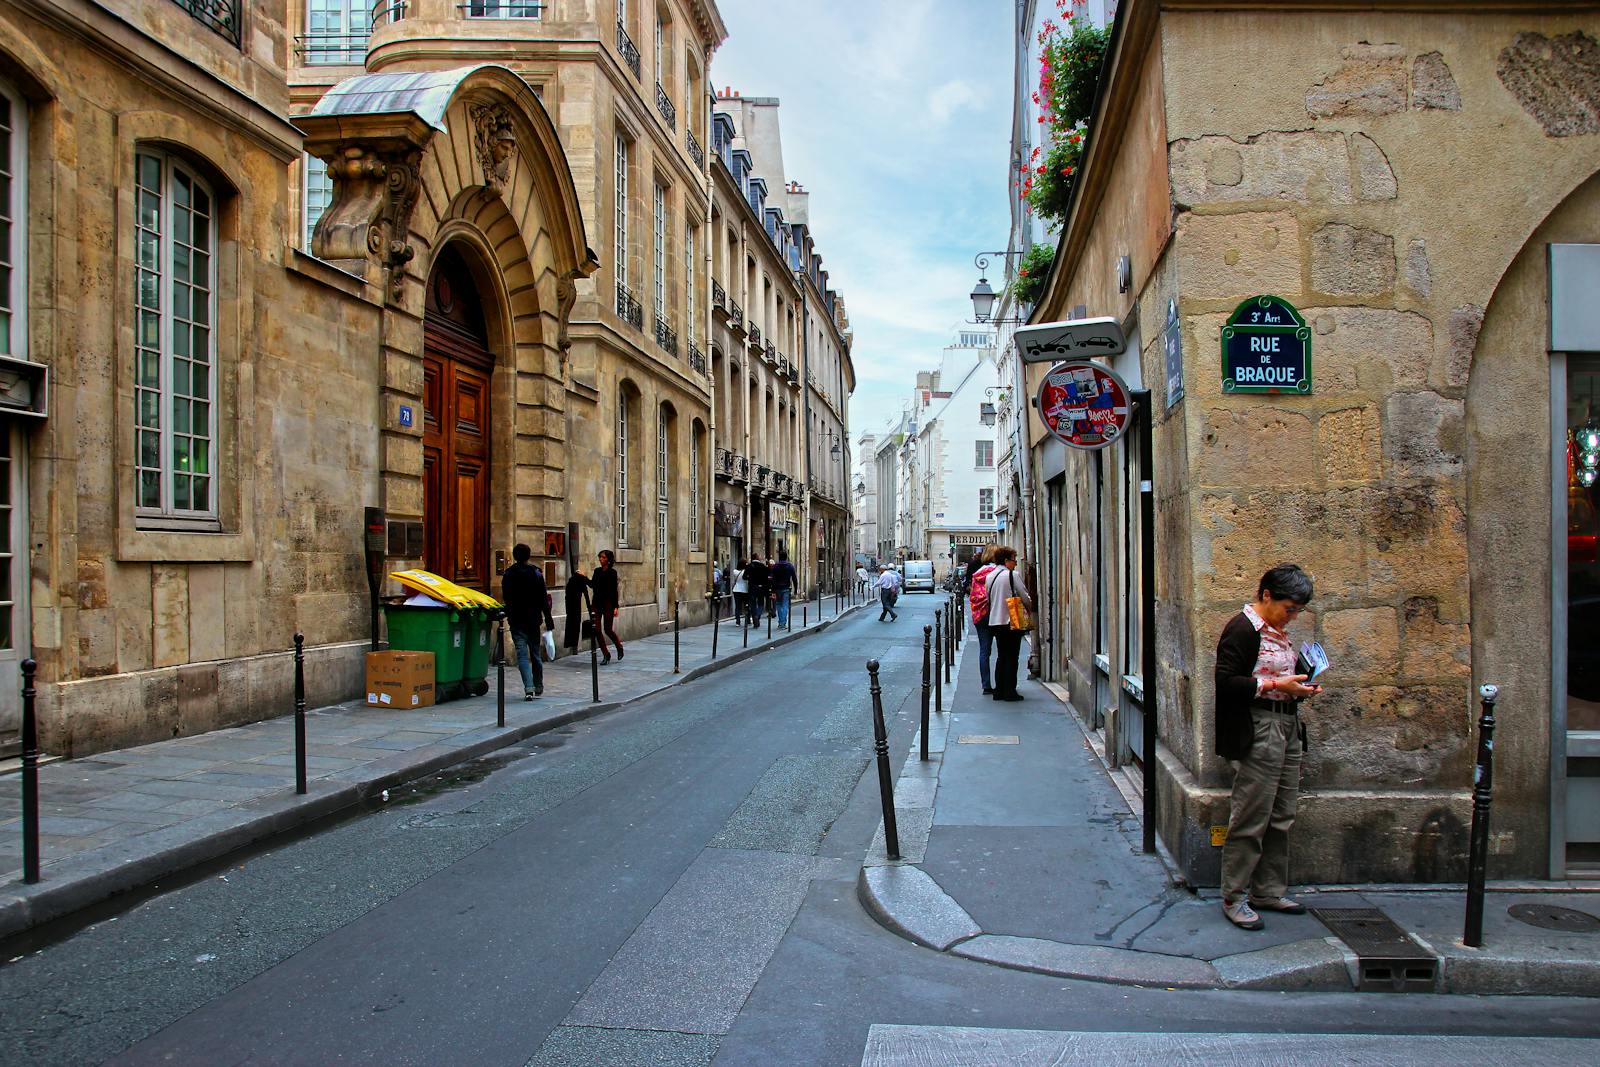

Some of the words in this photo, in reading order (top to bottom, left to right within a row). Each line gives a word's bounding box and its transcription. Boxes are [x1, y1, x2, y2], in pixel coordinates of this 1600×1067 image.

[1250, 336, 1280, 352] RUE
[1260, 355, 1271, 364] DE
[1235, 366, 1296, 383] BRAQUE
